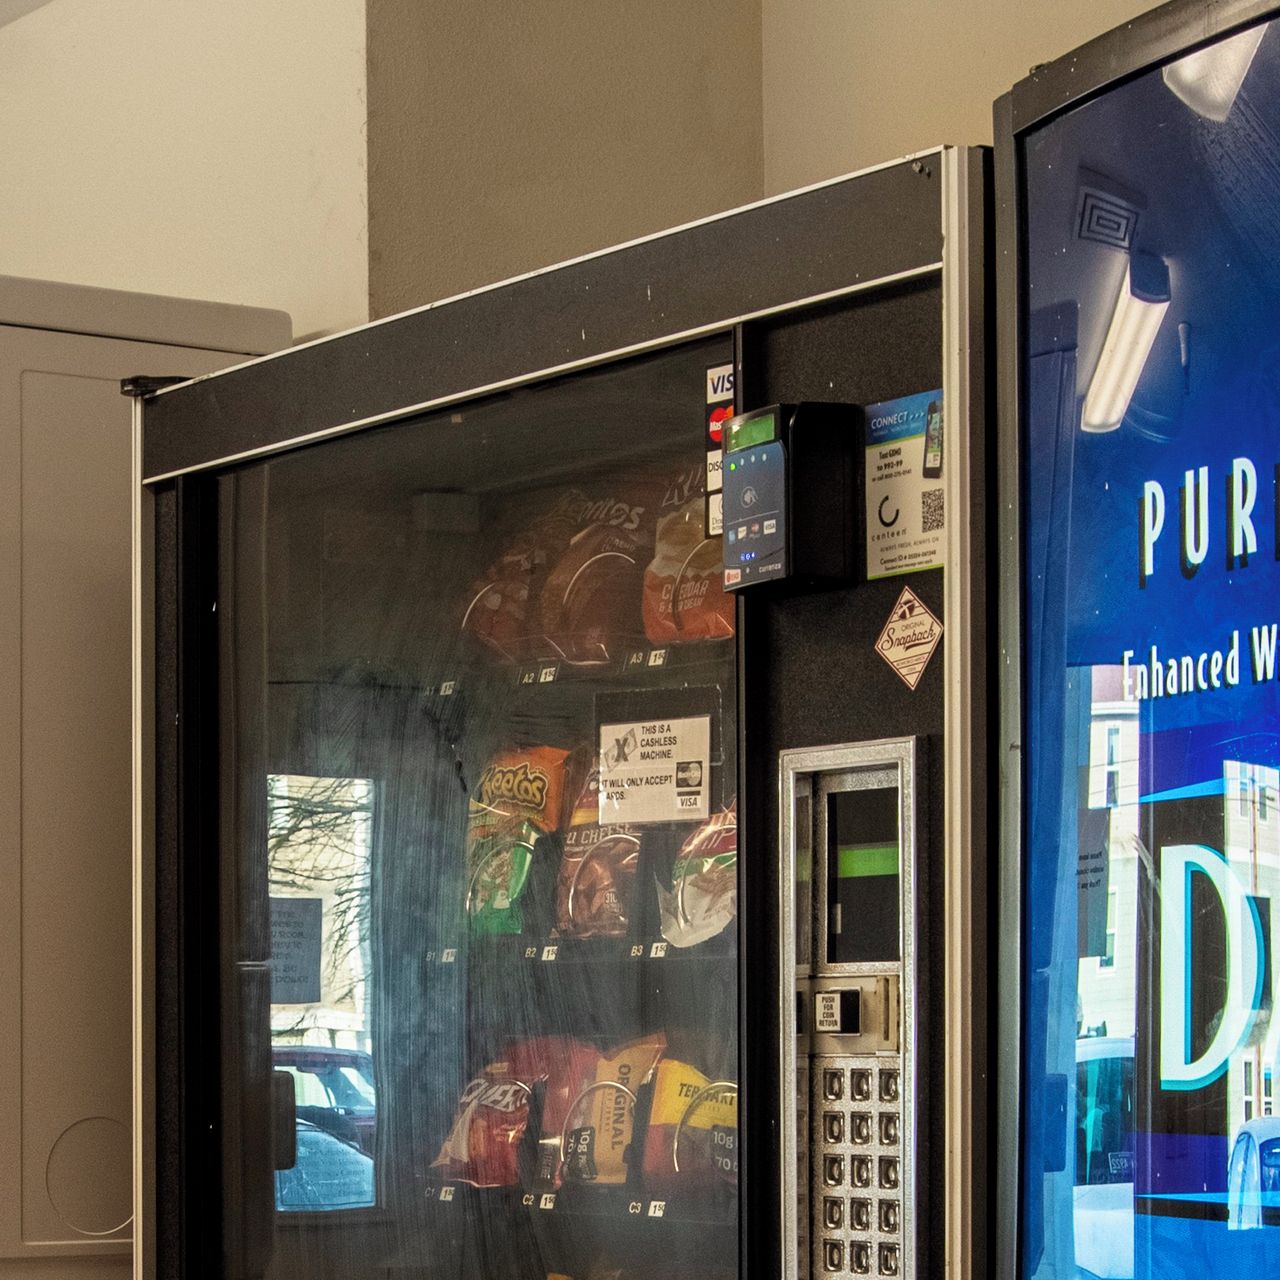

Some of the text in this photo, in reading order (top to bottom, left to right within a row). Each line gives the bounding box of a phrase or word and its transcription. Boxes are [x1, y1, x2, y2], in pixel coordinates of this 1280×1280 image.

[871, 411, 908, 430] CONNECT
[871, 528, 907, 542] canteen
[881, 620, 936, 651] Snapback
[630, 652, 643, 664] A3
[1120, 627, 1241, 704] Enhanced
[523, 673, 535, 683] A2
[642, 724, 671, 735] THIS IS A
[640, 736, 677, 748] CASHLESS
[609, 778, 627, 788] WILL
[627, 777, 644, 786] ONLY
[645, 775, 672, 785] ACCEPT
[680, 797, 698, 807] VISA
[526, 948, 537, 957] B2
[631, 945, 643, 956] B3
[713, 1131, 734, 1150] 10g
[715, 1157, 732, 1170] 70
[523, 1195, 534, 1206] C2
[629, 1202, 641, 1214] C3
